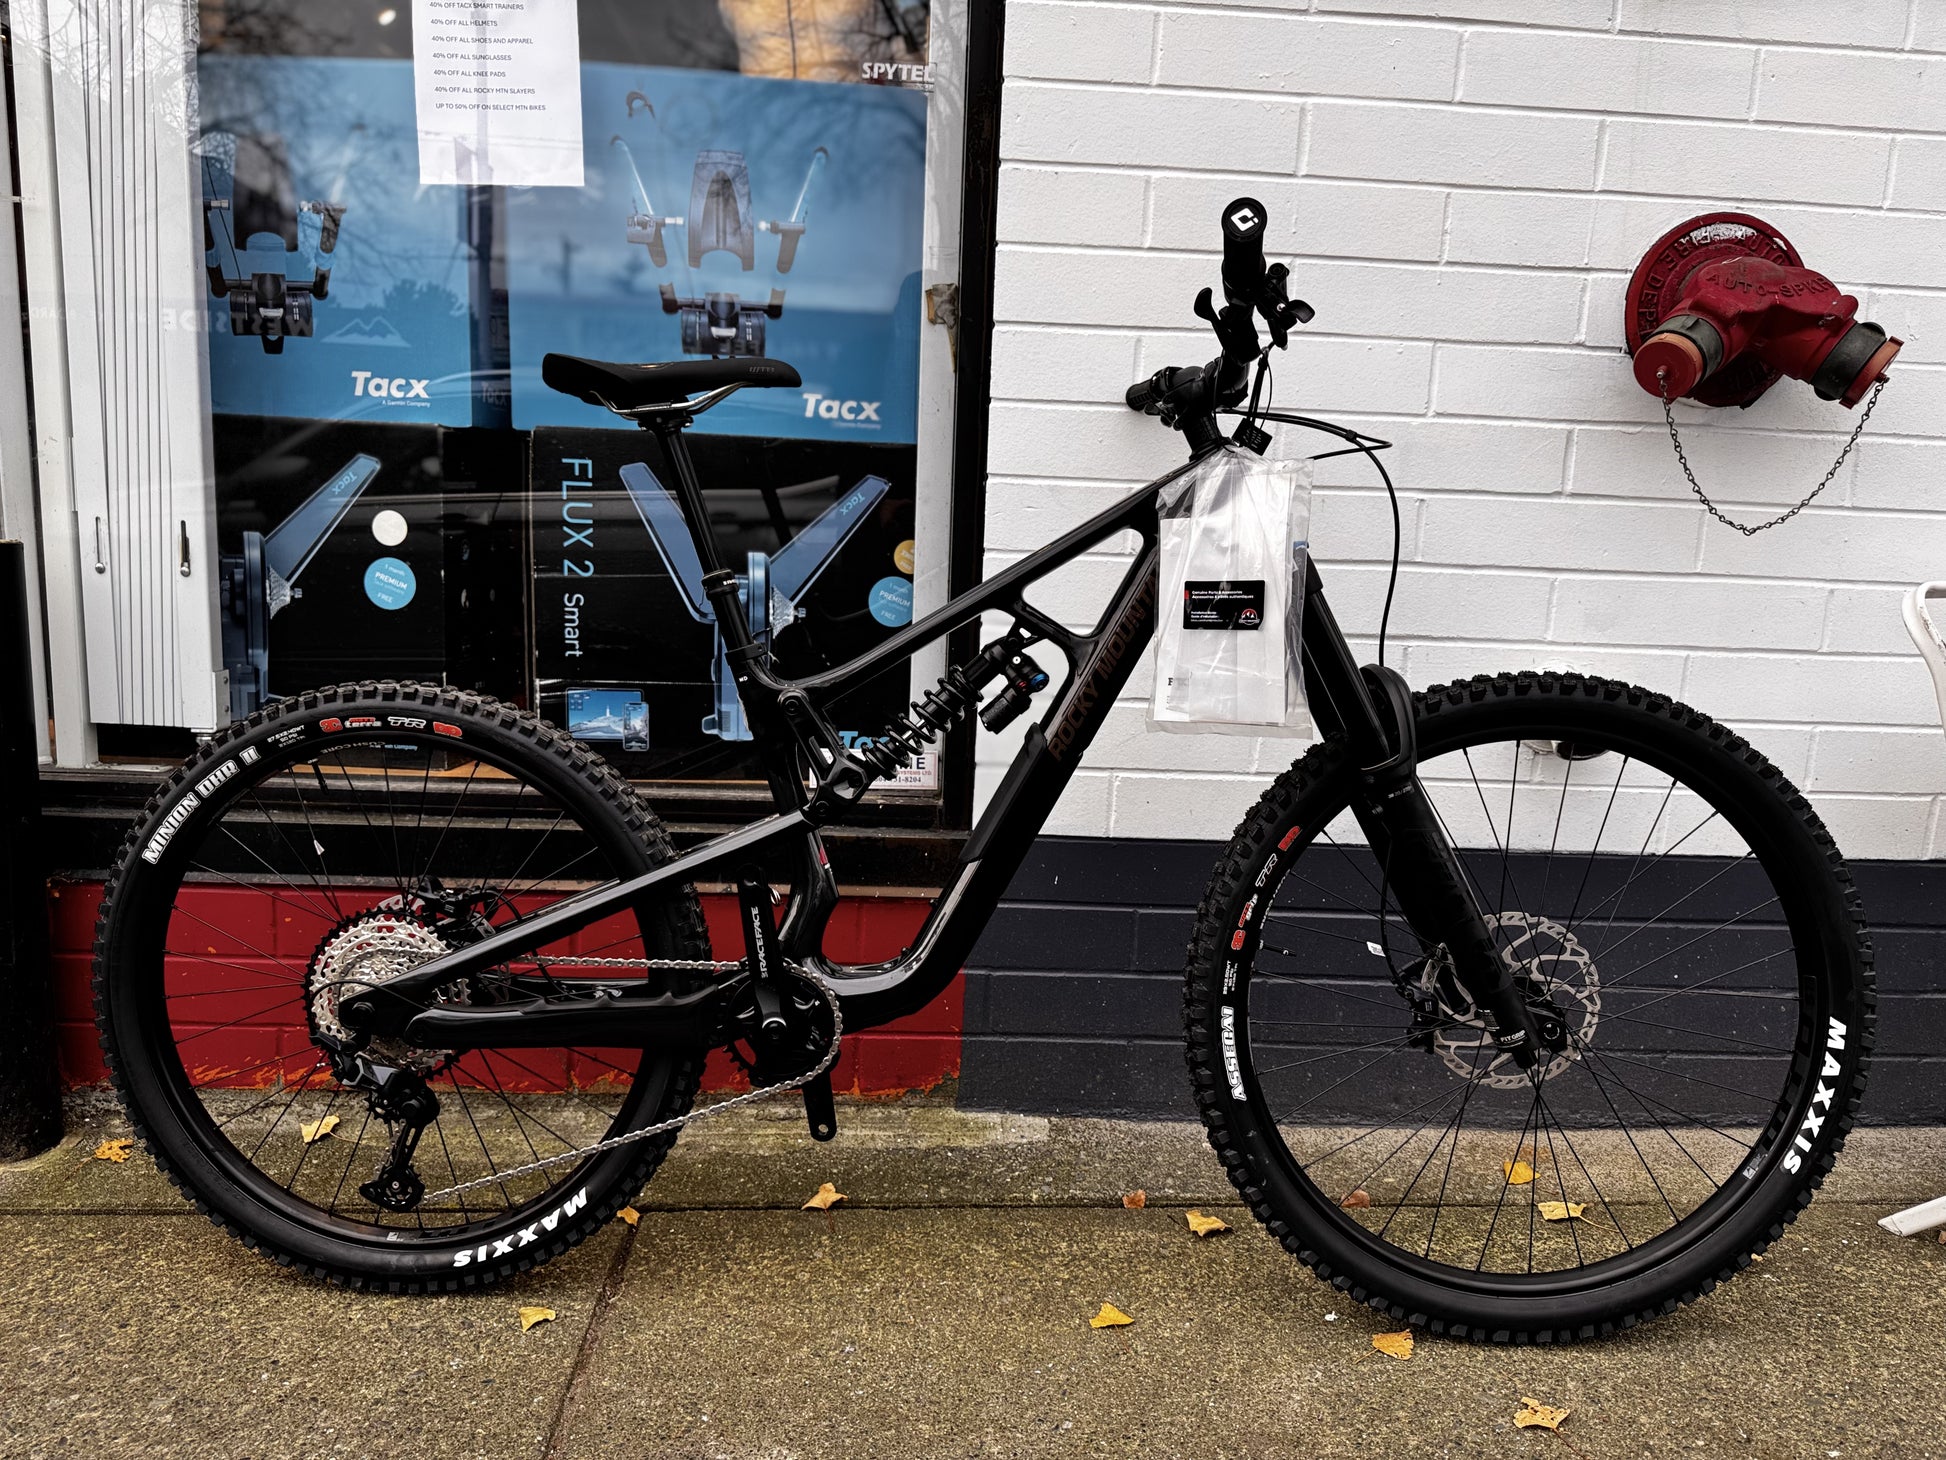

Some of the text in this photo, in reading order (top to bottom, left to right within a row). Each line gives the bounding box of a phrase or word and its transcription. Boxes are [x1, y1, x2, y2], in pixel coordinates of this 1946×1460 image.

[351, 371, 430, 398] Tacx
[406, 400, 431, 408] Company
[803, 393, 881, 421] Tacx
[332, 471, 358, 495] Tacx
[839, 492, 866, 516] Tacx
[562, 458, 595, 657] FLUX 2 Smart
[375, 571, 408, 590] PREMIUM
[377, 592, 393, 603] FREE
[879, 590, 911, 607] PREMIUM
[880, 609, 897, 621] FREE
[344, 720, 382, 729] terra
[387, 716, 427, 729] TR
[1049, 674, 1100, 761] ROCKY
[142, 745, 262, 864] MINION DHR II
[1254, 852, 1279, 888] TR
[1245, 893, 1259, 921] grip
[750, 906, 767, 972] RACEFACE
[1221, 1005, 1248, 1102] ASSEGAI
[1783, 1016, 1847, 1175] MAXXIS
[452, 1186, 588, 1268] MAXXIS
